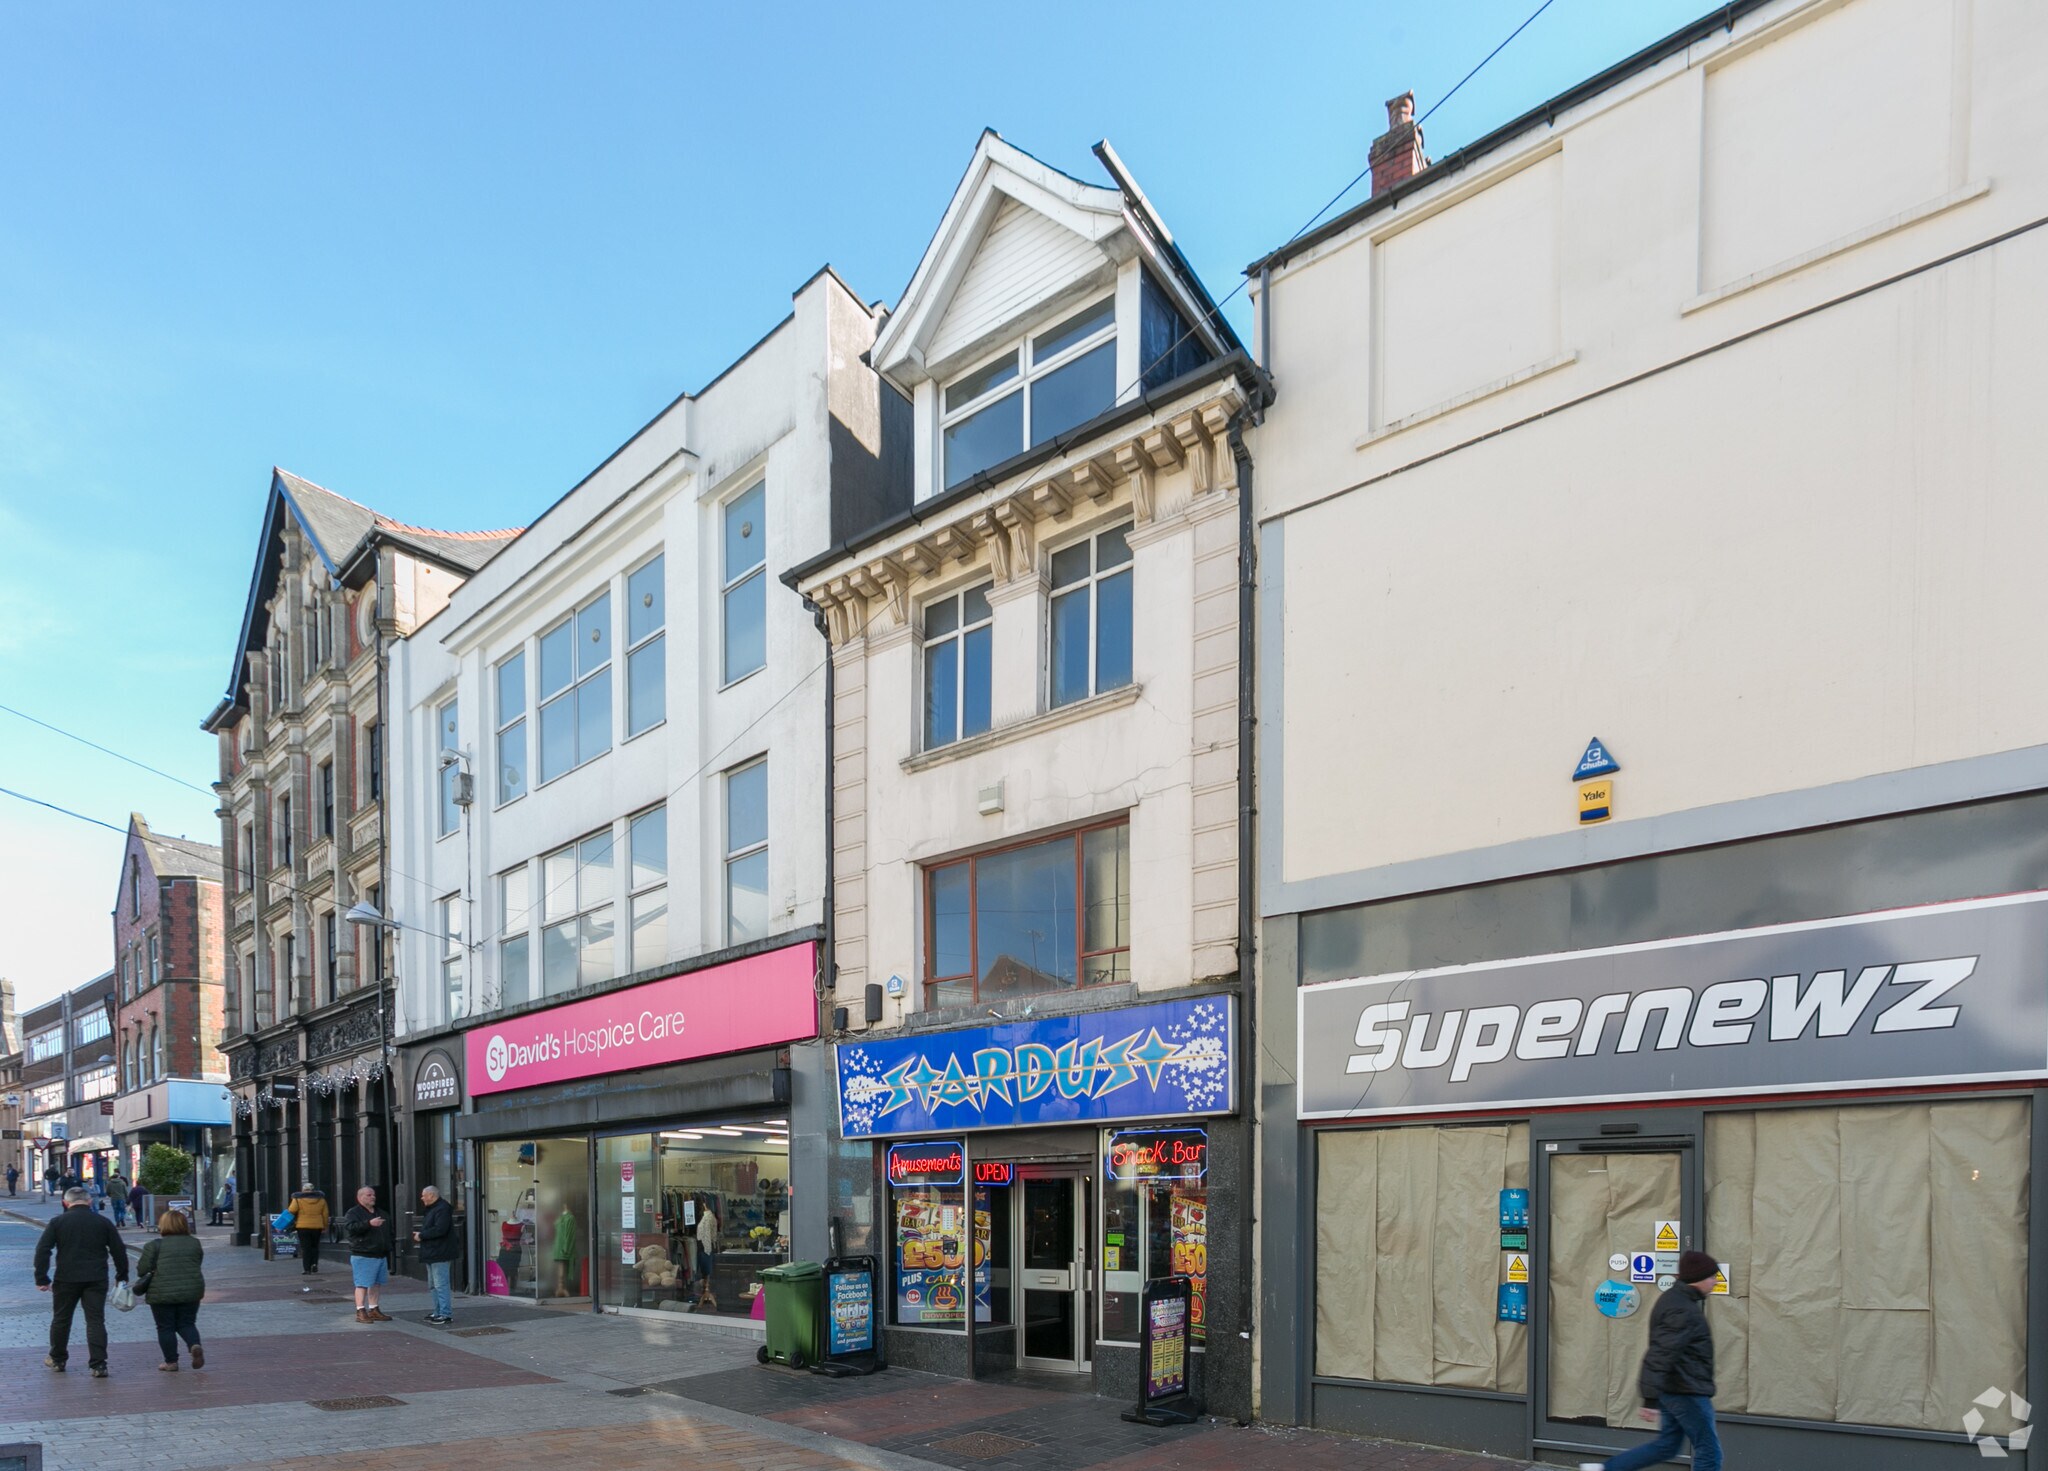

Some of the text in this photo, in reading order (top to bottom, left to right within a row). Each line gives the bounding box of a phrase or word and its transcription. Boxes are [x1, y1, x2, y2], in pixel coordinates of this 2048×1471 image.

[1581, 759, 1608, 770] Chubb
[1583, 790, 1606, 801] Yale
[1345, 955, 1981, 1083] Supernewz
[489, 1011, 685, 1070] St David's Hospice Care
[878, 1026, 1184, 1118] STARDUST
[416, 1077, 455, 1092] WOODFIRED
[417, 1087, 455, 1101] XPRESS
[1172, 1140, 1206, 1164] Bar
[891, 1152, 961, 1178] Amusements
[976, 1162, 1009, 1181] OPEN
[904, 1216, 923, 1228] BAR
[975, 1228, 988, 1238] AR
[902, 1272, 922, 1287] PLUS
[835, 1283, 854, 1291] Follow
[1509, 1286, 1520, 1294] blu
[837, 1290, 867, 1299] Facebook
